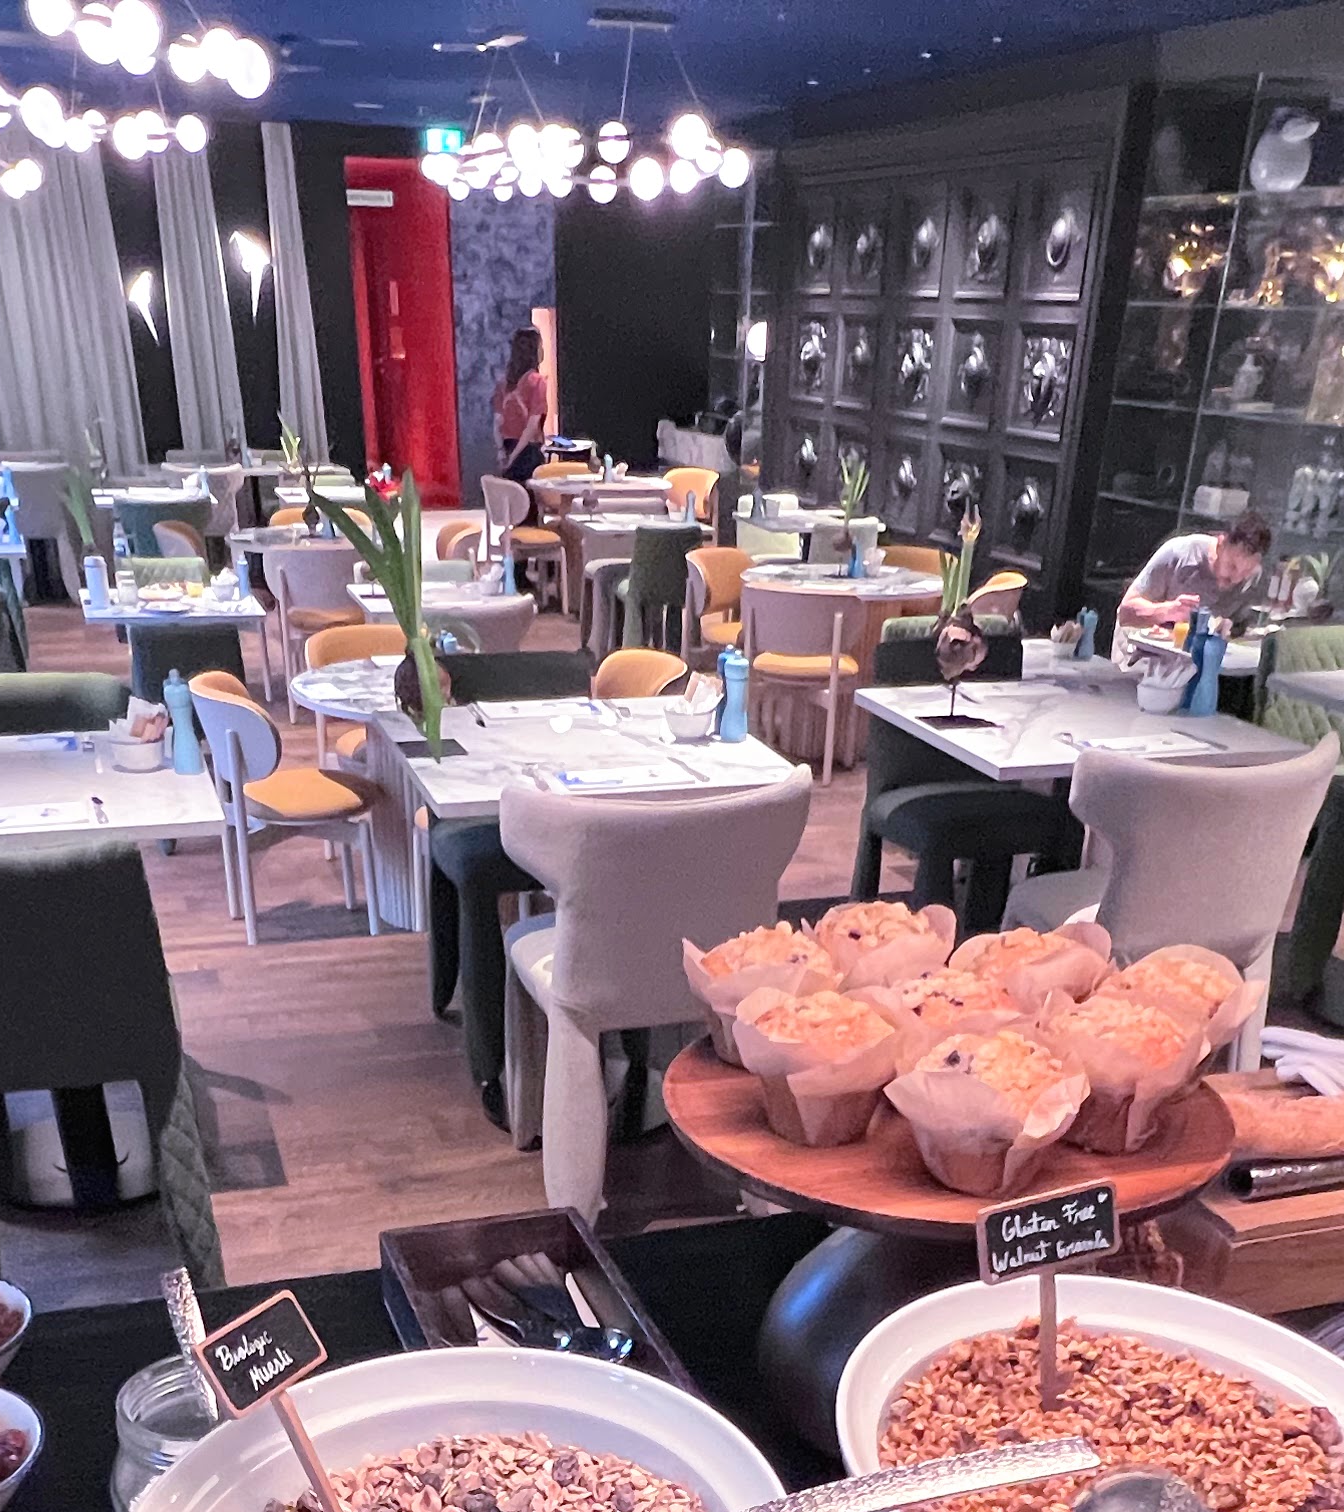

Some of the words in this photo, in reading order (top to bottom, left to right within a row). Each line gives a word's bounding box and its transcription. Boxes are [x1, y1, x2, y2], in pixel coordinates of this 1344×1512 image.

[1001, 1211, 1060, 1243] Gluten
[1061, 1200, 1097, 1226] Free
[992, 1240, 1052, 1273] Walnut
[1056, 1229, 1110, 1260] Granola
[214, 1330, 273, 1372] Biologic
[248, 1347, 294, 1392] Muesli
